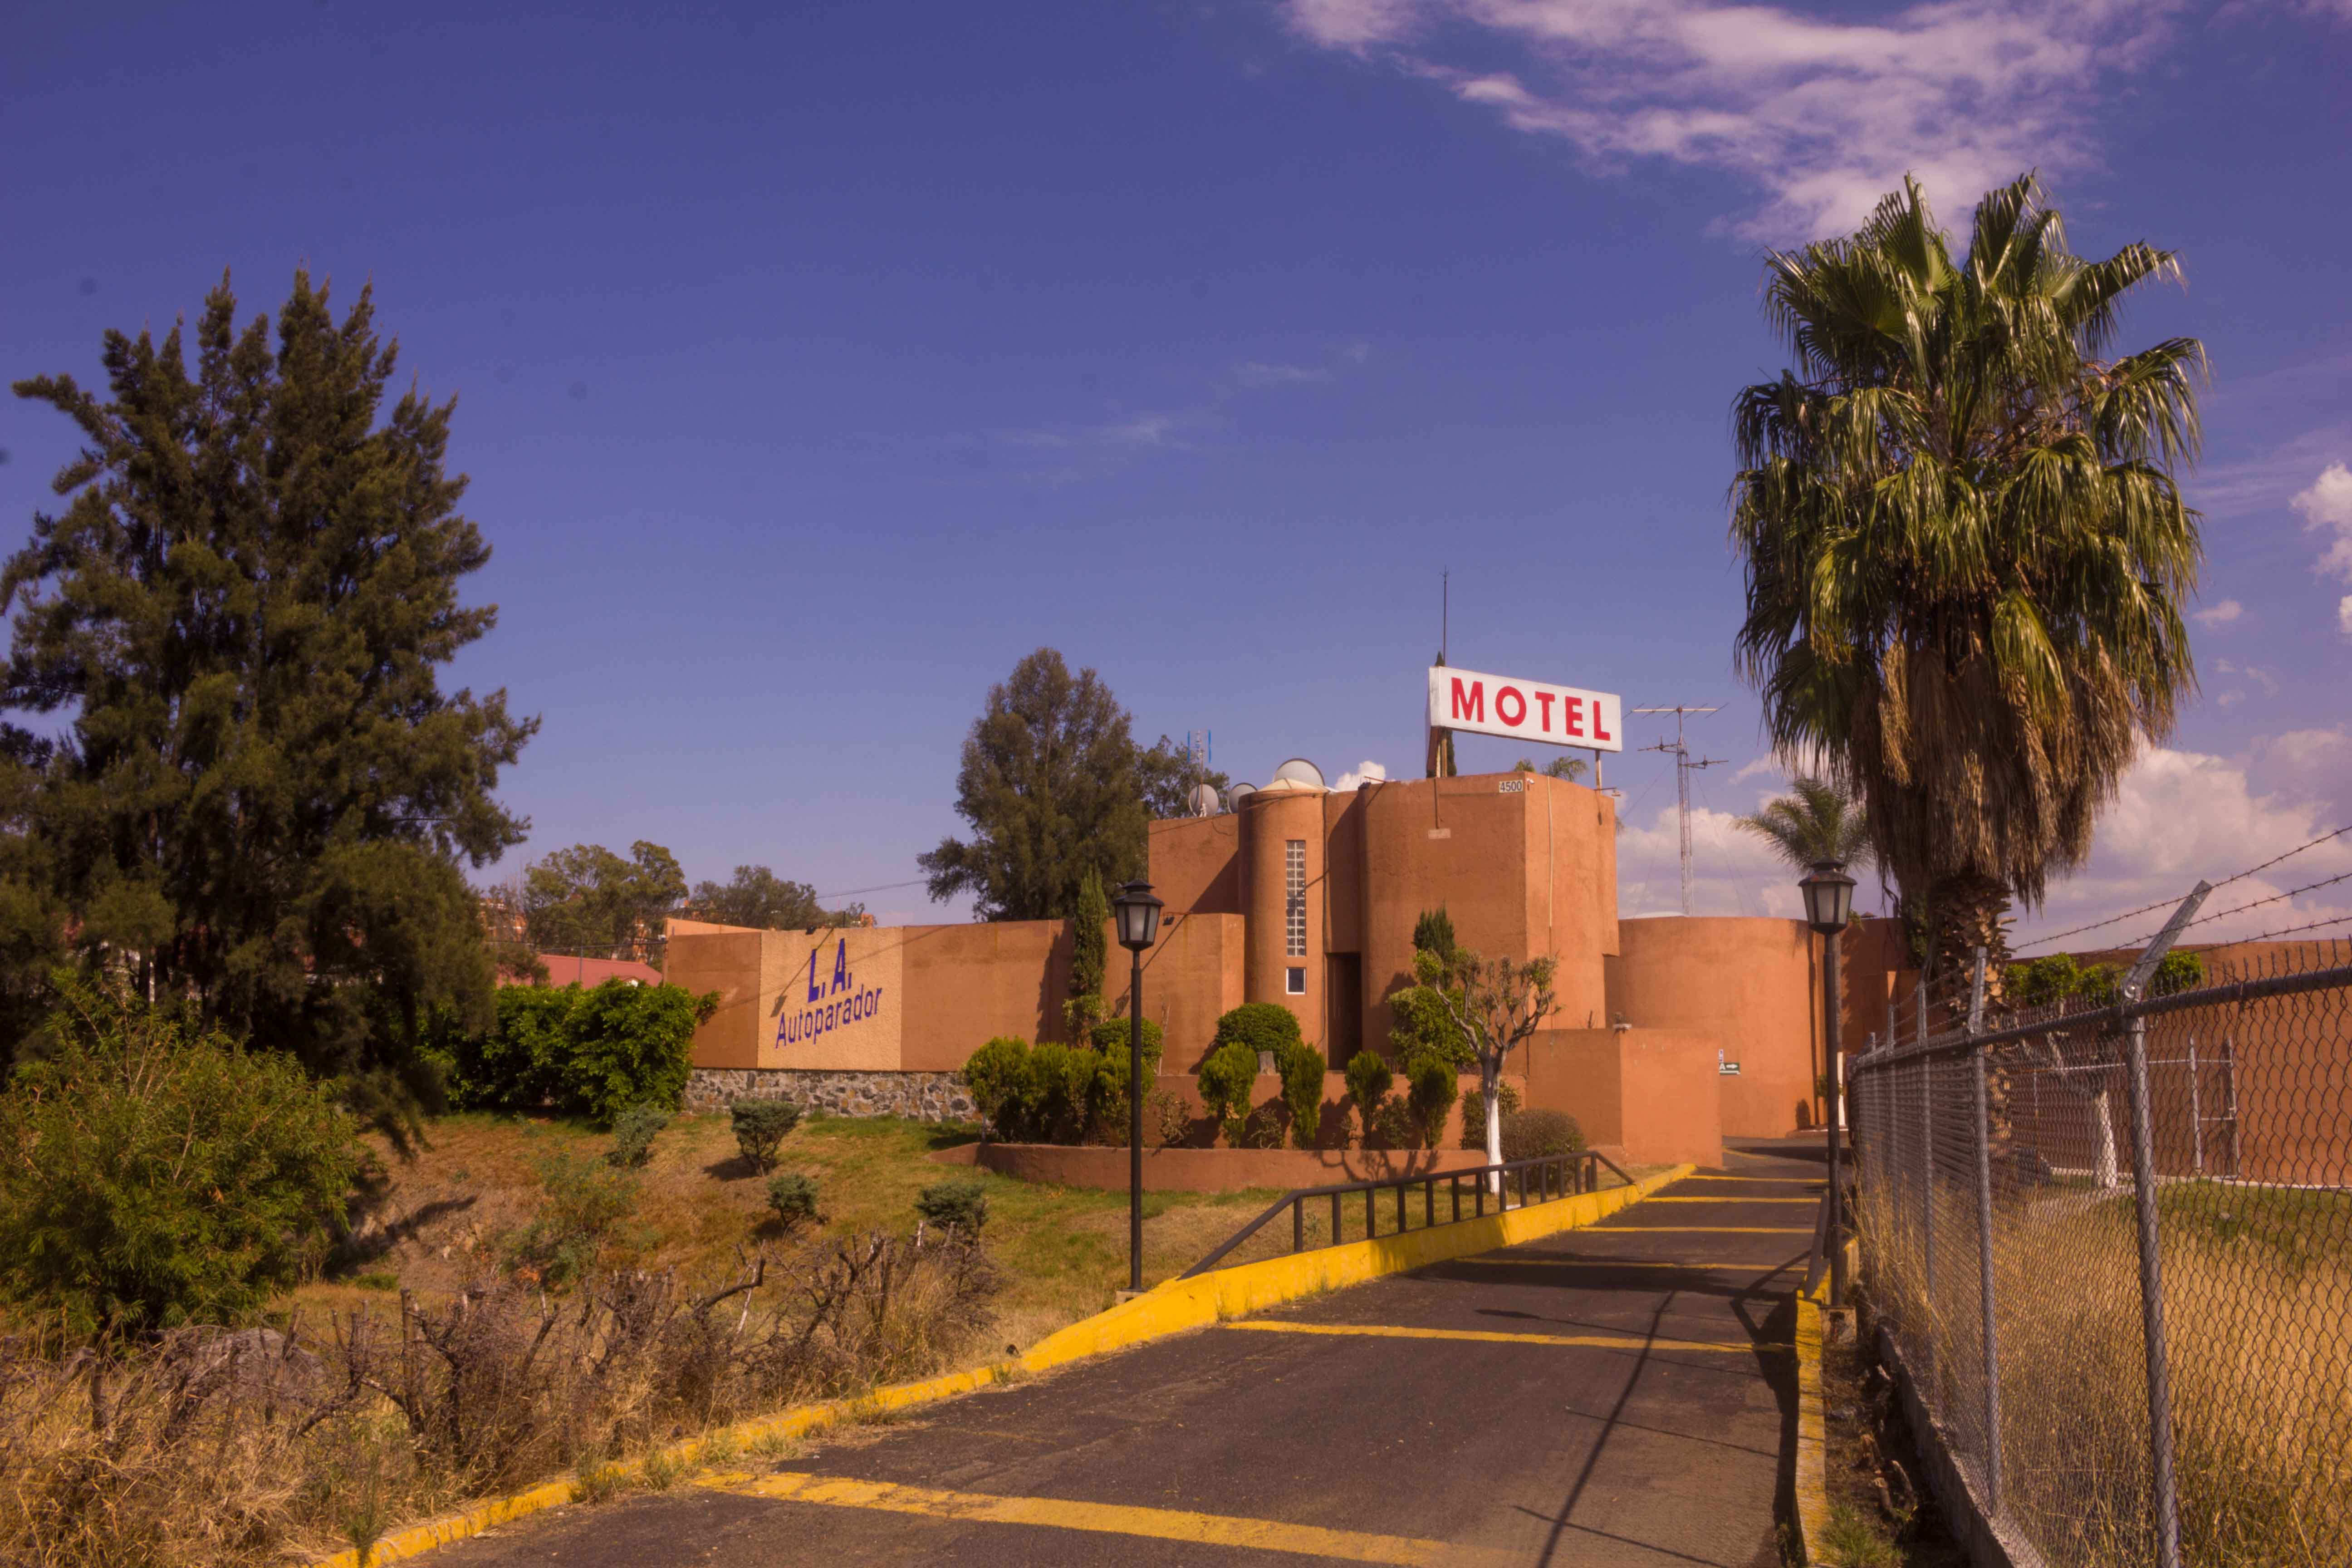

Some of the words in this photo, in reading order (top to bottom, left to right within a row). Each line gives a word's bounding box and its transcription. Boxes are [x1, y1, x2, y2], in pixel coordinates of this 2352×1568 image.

[1451, 677, 1610, 741] MOTEL
[1500, 781, 1522, 792] 4500
[775, 984, 882, 1049] Autoparador
